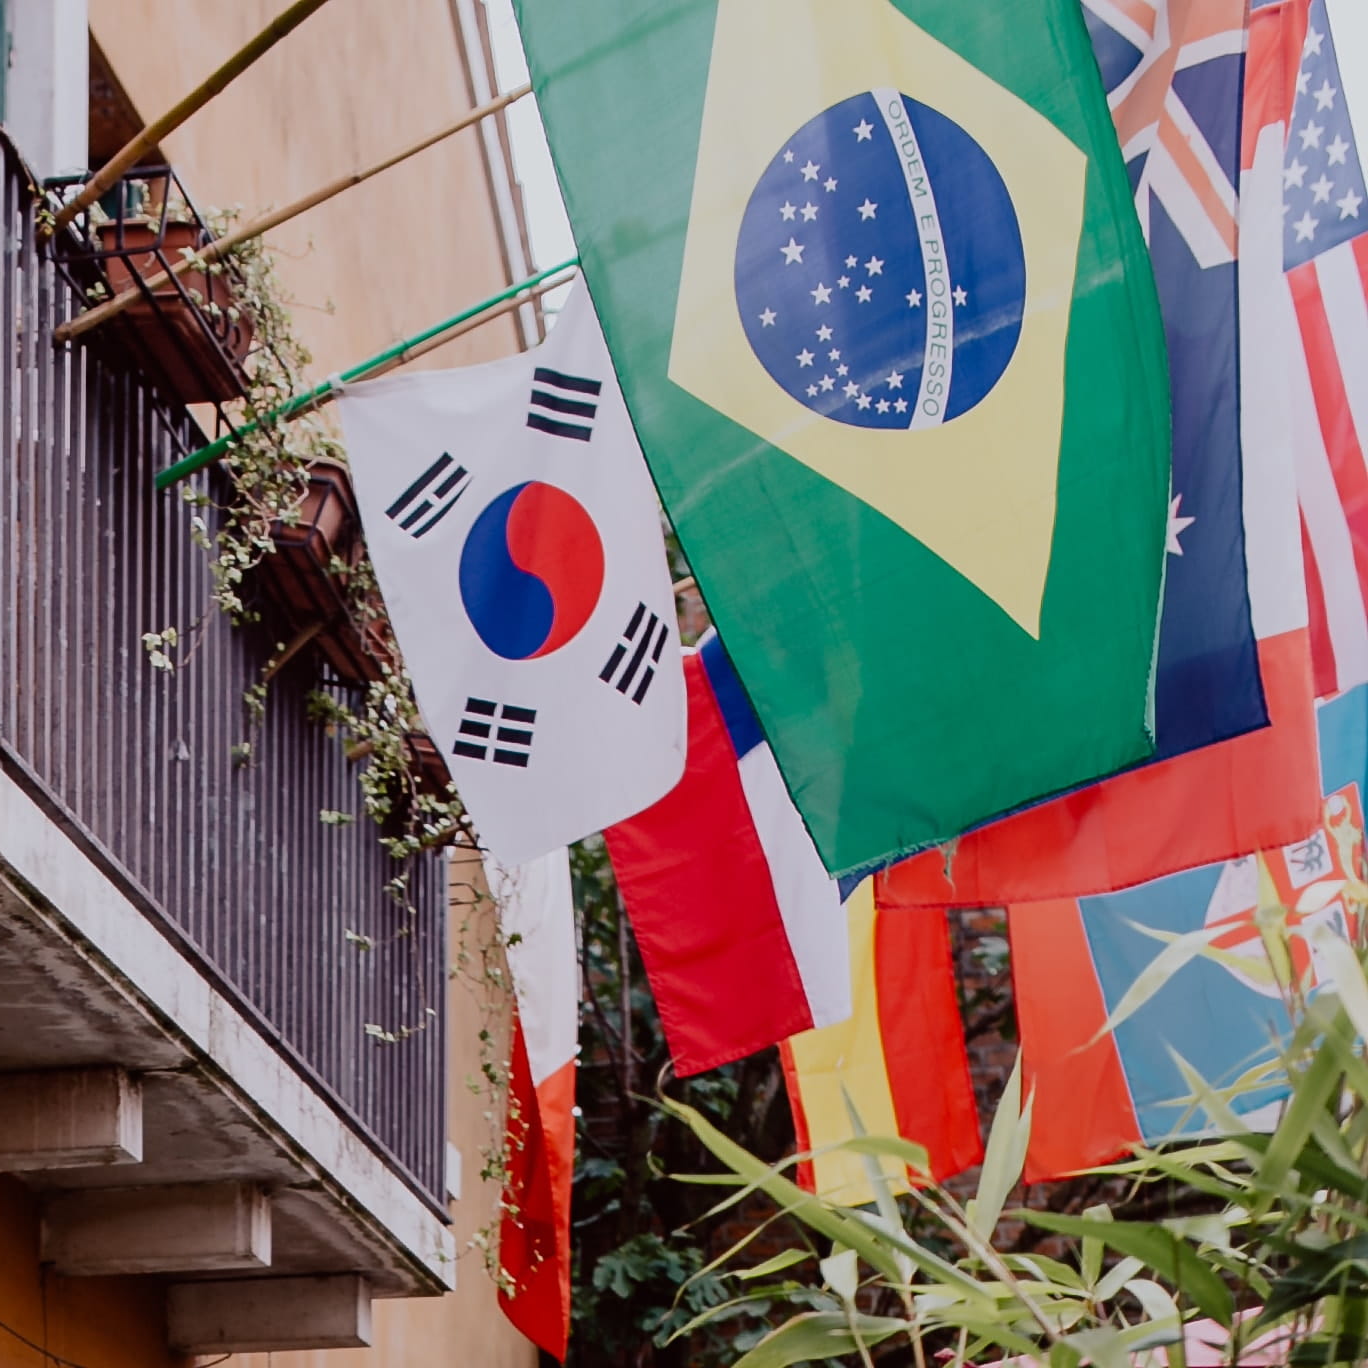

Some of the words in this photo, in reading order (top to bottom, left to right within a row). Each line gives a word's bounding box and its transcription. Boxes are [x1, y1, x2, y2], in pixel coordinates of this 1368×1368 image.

[888, 100, 927, 198] ORDEM
[920, 214, 934, 231] E
[922, 240, 948, 417] PROGRESSO
